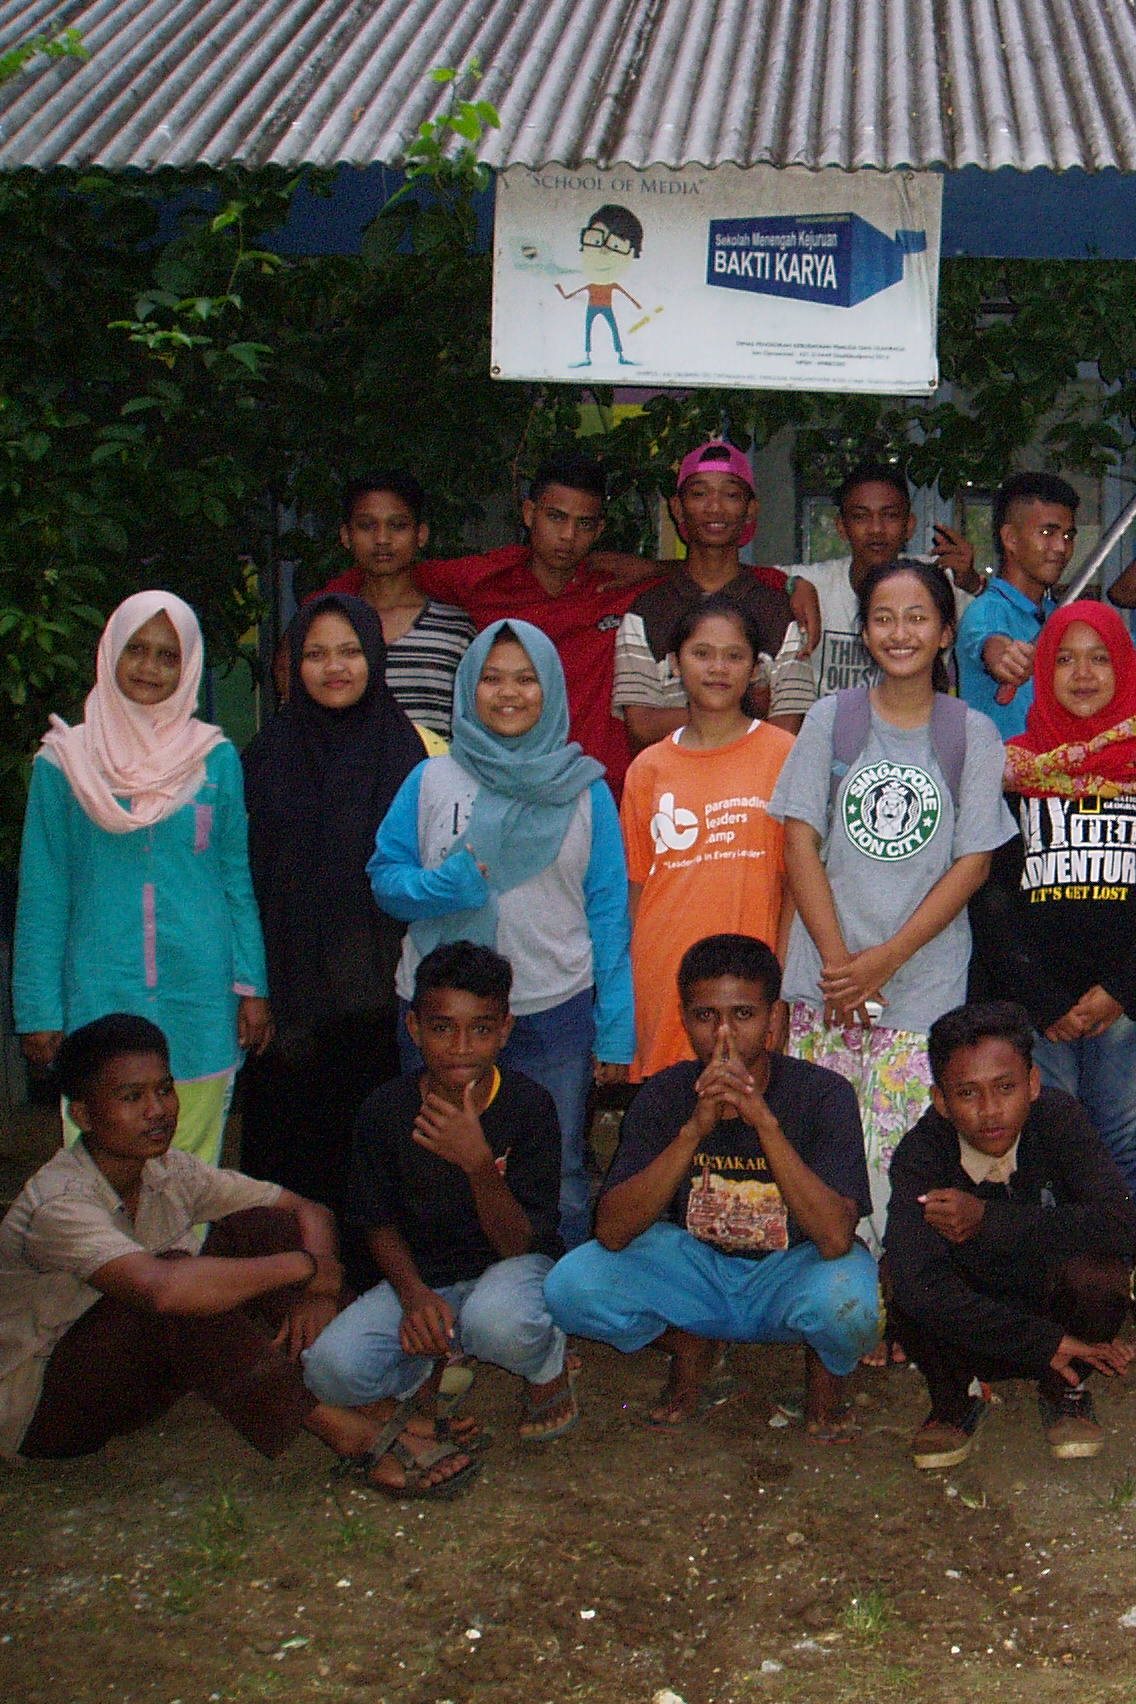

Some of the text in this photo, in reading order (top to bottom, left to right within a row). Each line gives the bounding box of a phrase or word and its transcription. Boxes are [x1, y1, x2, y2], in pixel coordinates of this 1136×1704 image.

[611, 178, 632, 192] OF
[715, 230, 838, 251] Sekolah Menengah Kejuruan
[714, 250, 838, 290] BAKTI KARYA
[849, 764, 937, 811] SINGAPORE
[705, 813, 748, 829] leaders
[848, 820, 924, 857] LION CITY
[1065, 886, 1091, 900] GET
[1093, 886, 1129, 901] LOST
